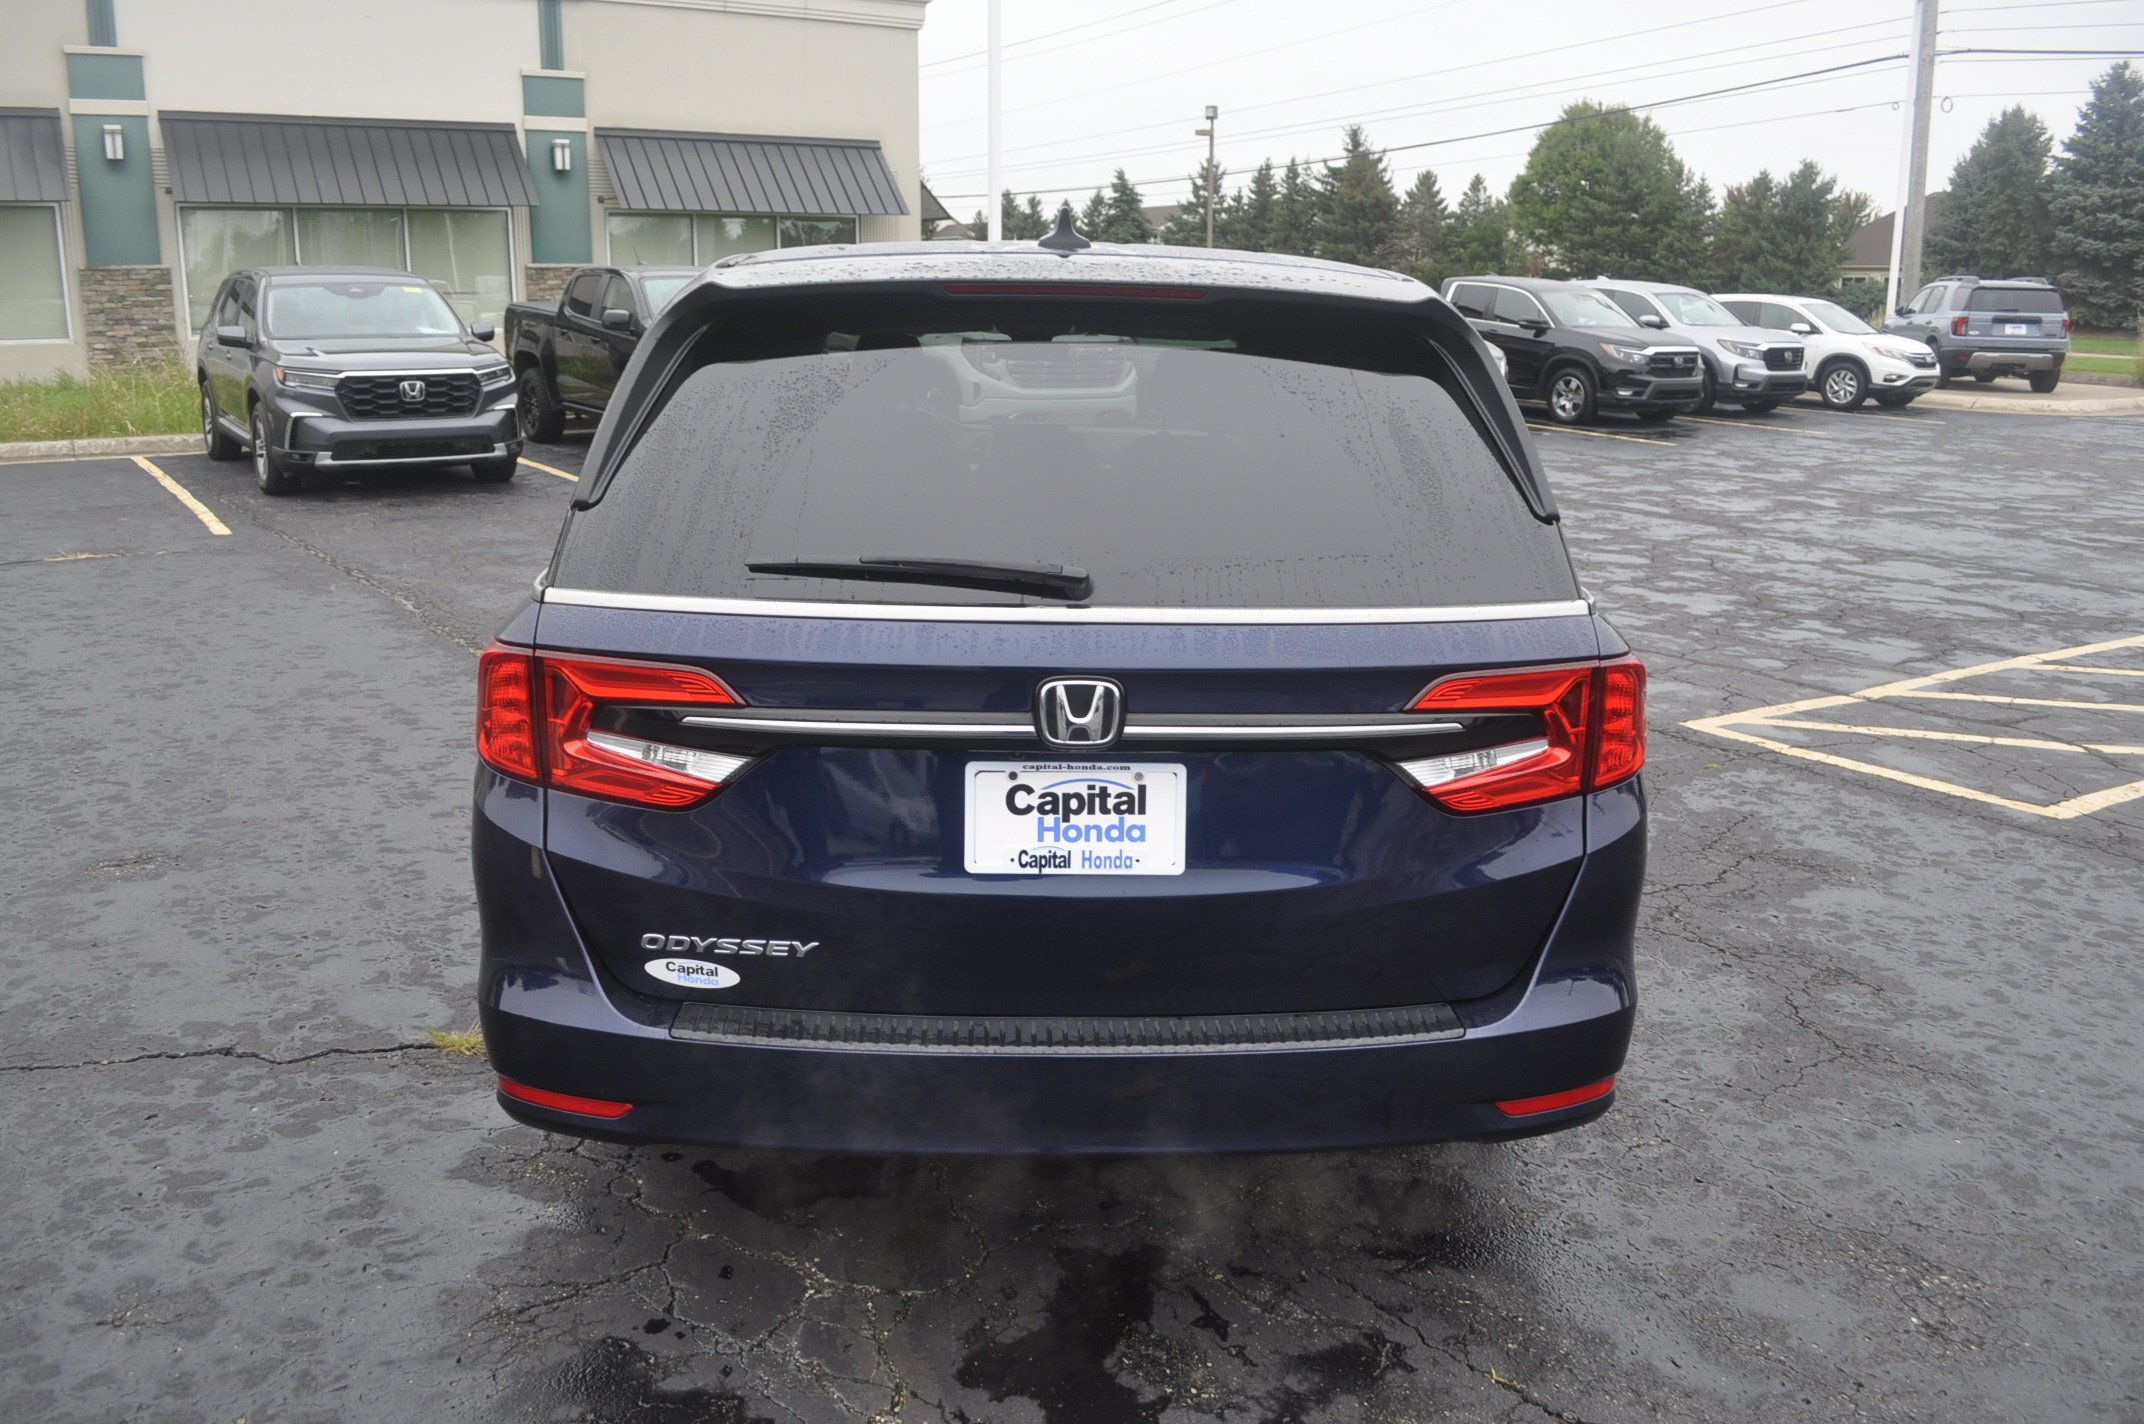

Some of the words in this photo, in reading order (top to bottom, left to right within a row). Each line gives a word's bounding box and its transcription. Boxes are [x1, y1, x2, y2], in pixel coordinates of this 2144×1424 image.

[1005, 784, 1147, 823] Capital
[1037, 816, 1146, 843] Honda
[1018, 850, 1072, 873] Capital
[1081, 850, 1133, 870] Honda
[640, 933, 820, 958] ODYSSEY
[665, 961, 719, 977] Capital
[677, 974, 720, 986] Honda
